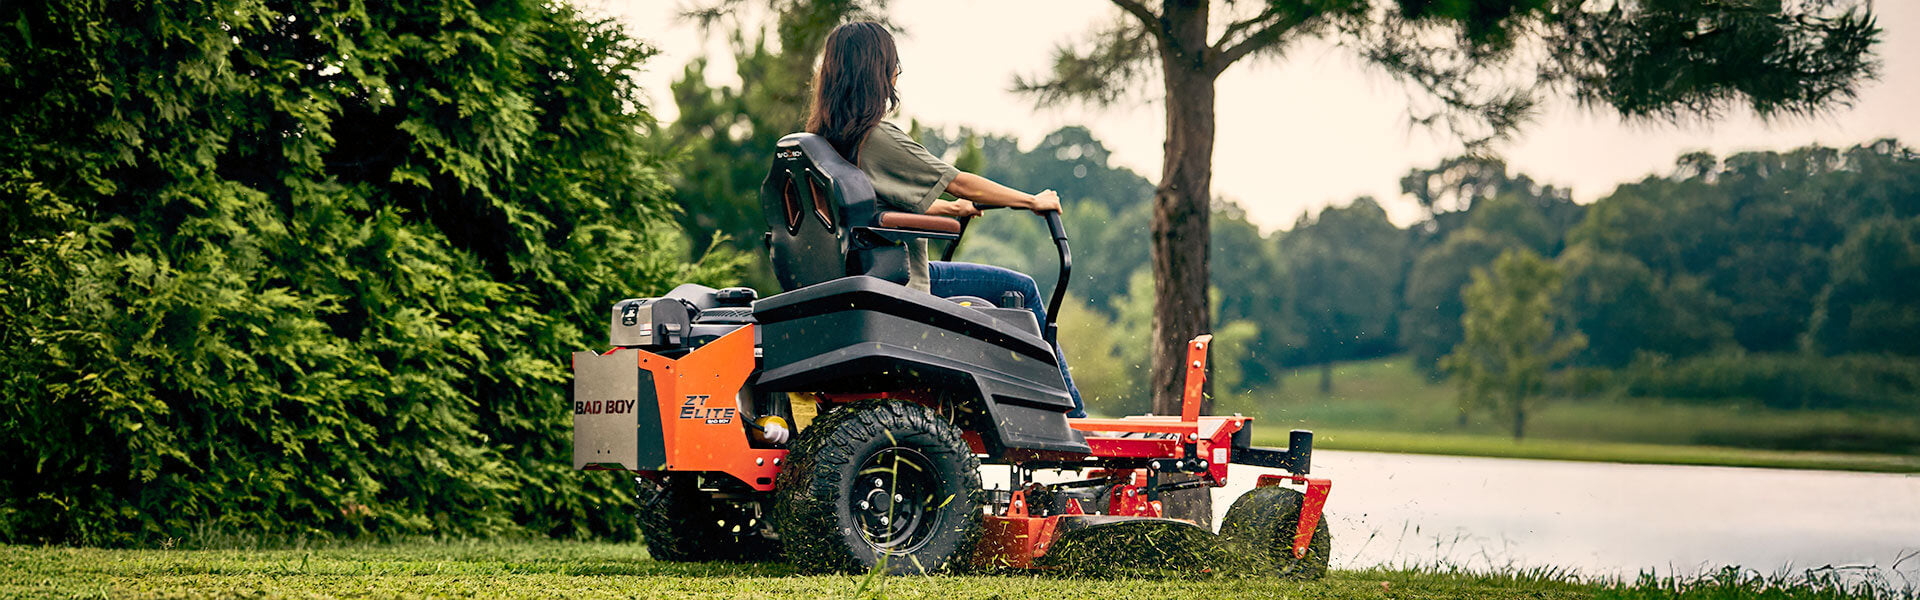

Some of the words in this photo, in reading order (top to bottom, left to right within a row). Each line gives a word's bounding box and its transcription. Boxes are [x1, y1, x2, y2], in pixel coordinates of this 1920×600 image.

[684, 395, 710, 406] ZT
[575, 400, 602, 415] BAD
[605, 399, 635, 414] BOY
[680, 407, 735, 418] ELITE
